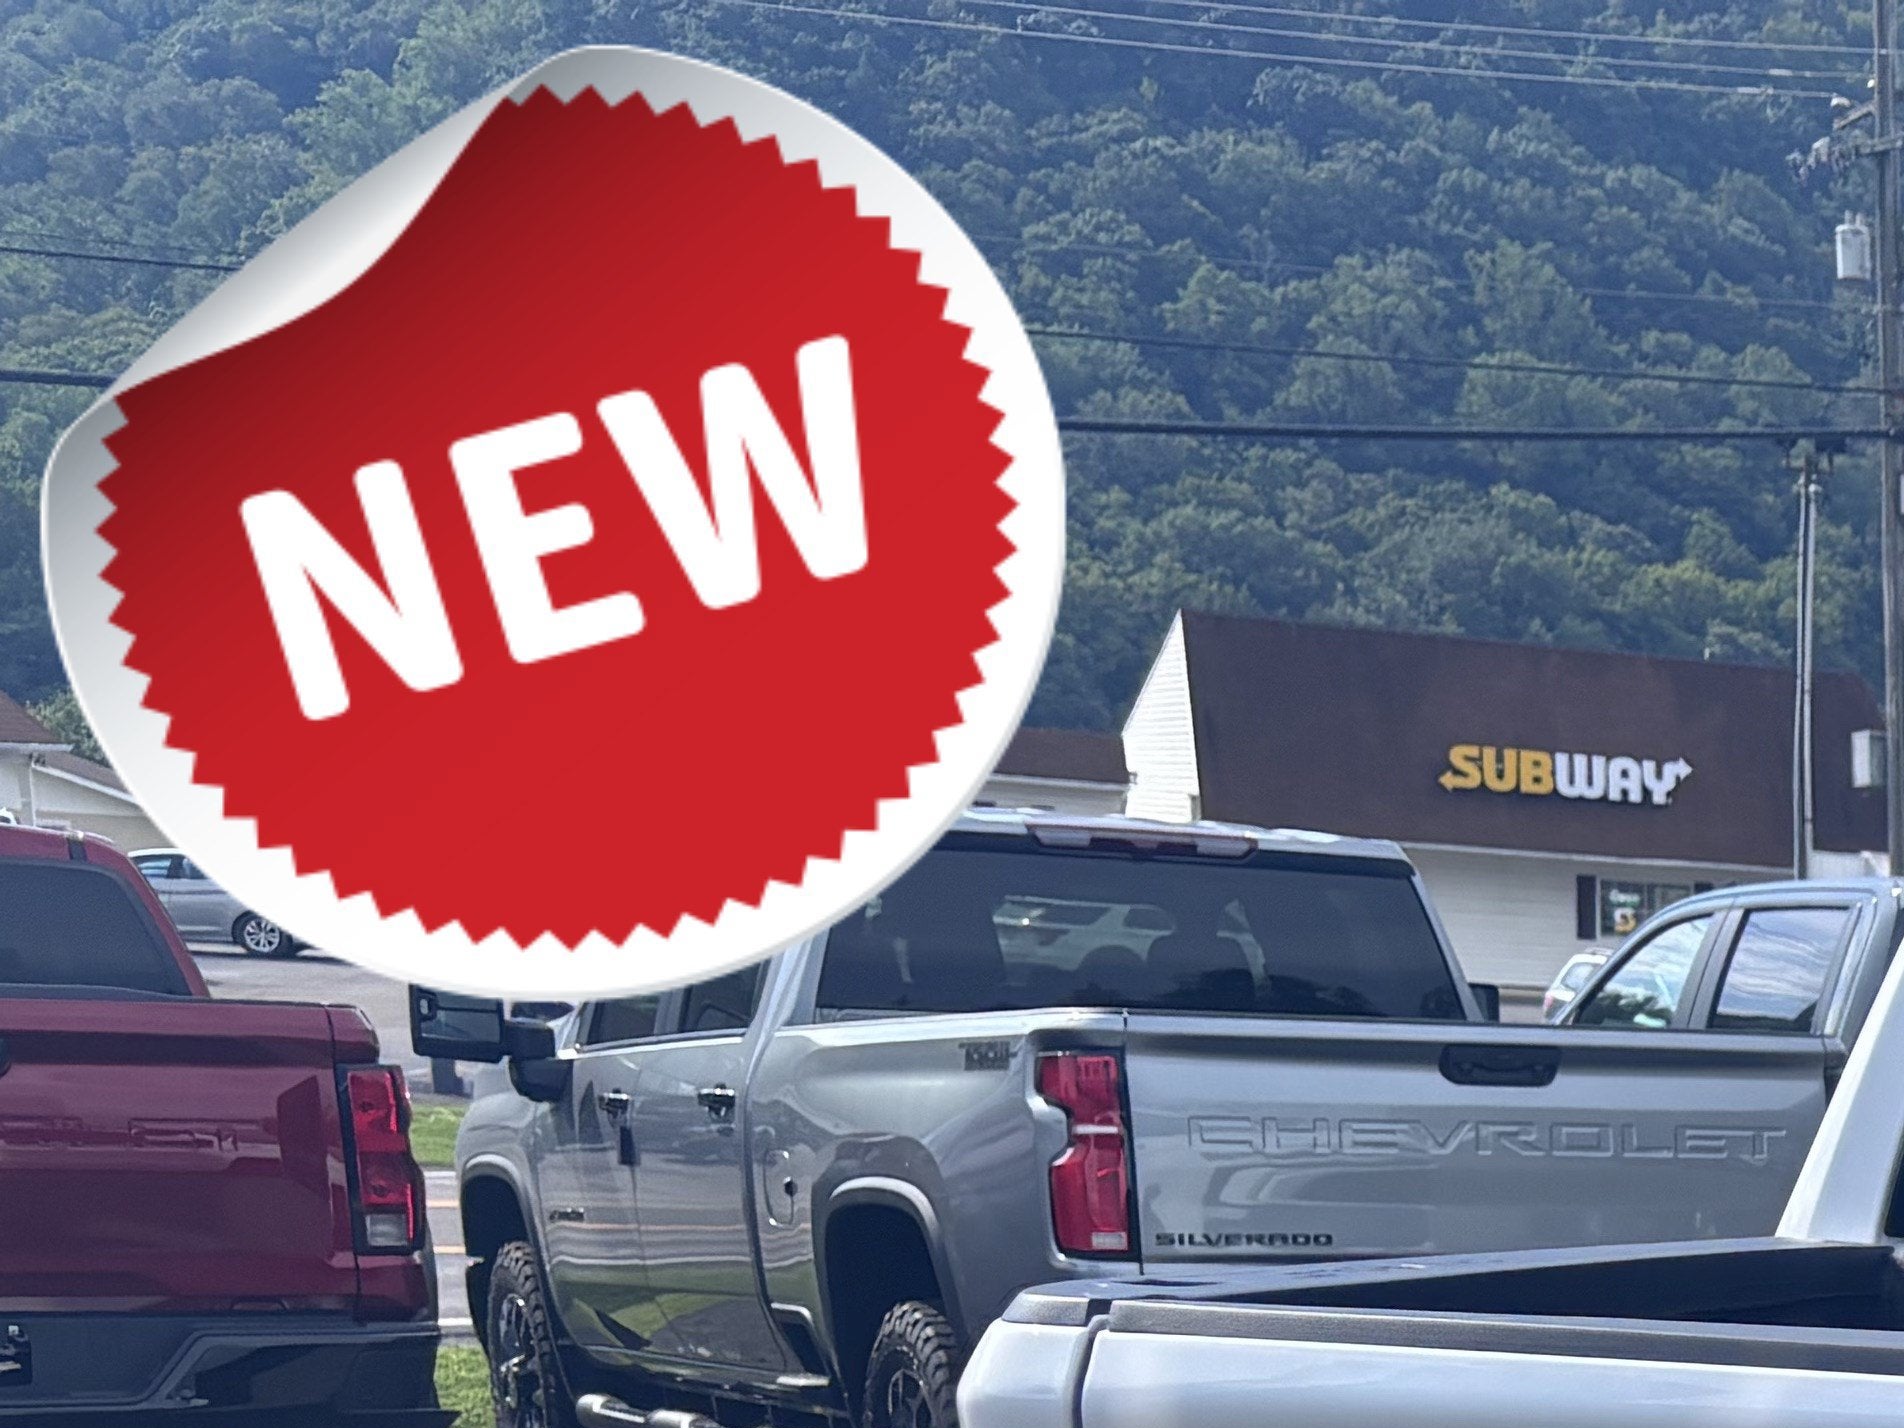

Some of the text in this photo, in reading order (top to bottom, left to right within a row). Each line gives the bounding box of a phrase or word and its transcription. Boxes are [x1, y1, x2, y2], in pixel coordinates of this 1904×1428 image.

[1437, 744, 1693, 806] SUBWAY
[1187, 1115, 1787, 1166] CHEVROLET
[1154, 1232, 1334, 1247] SILVERADO
